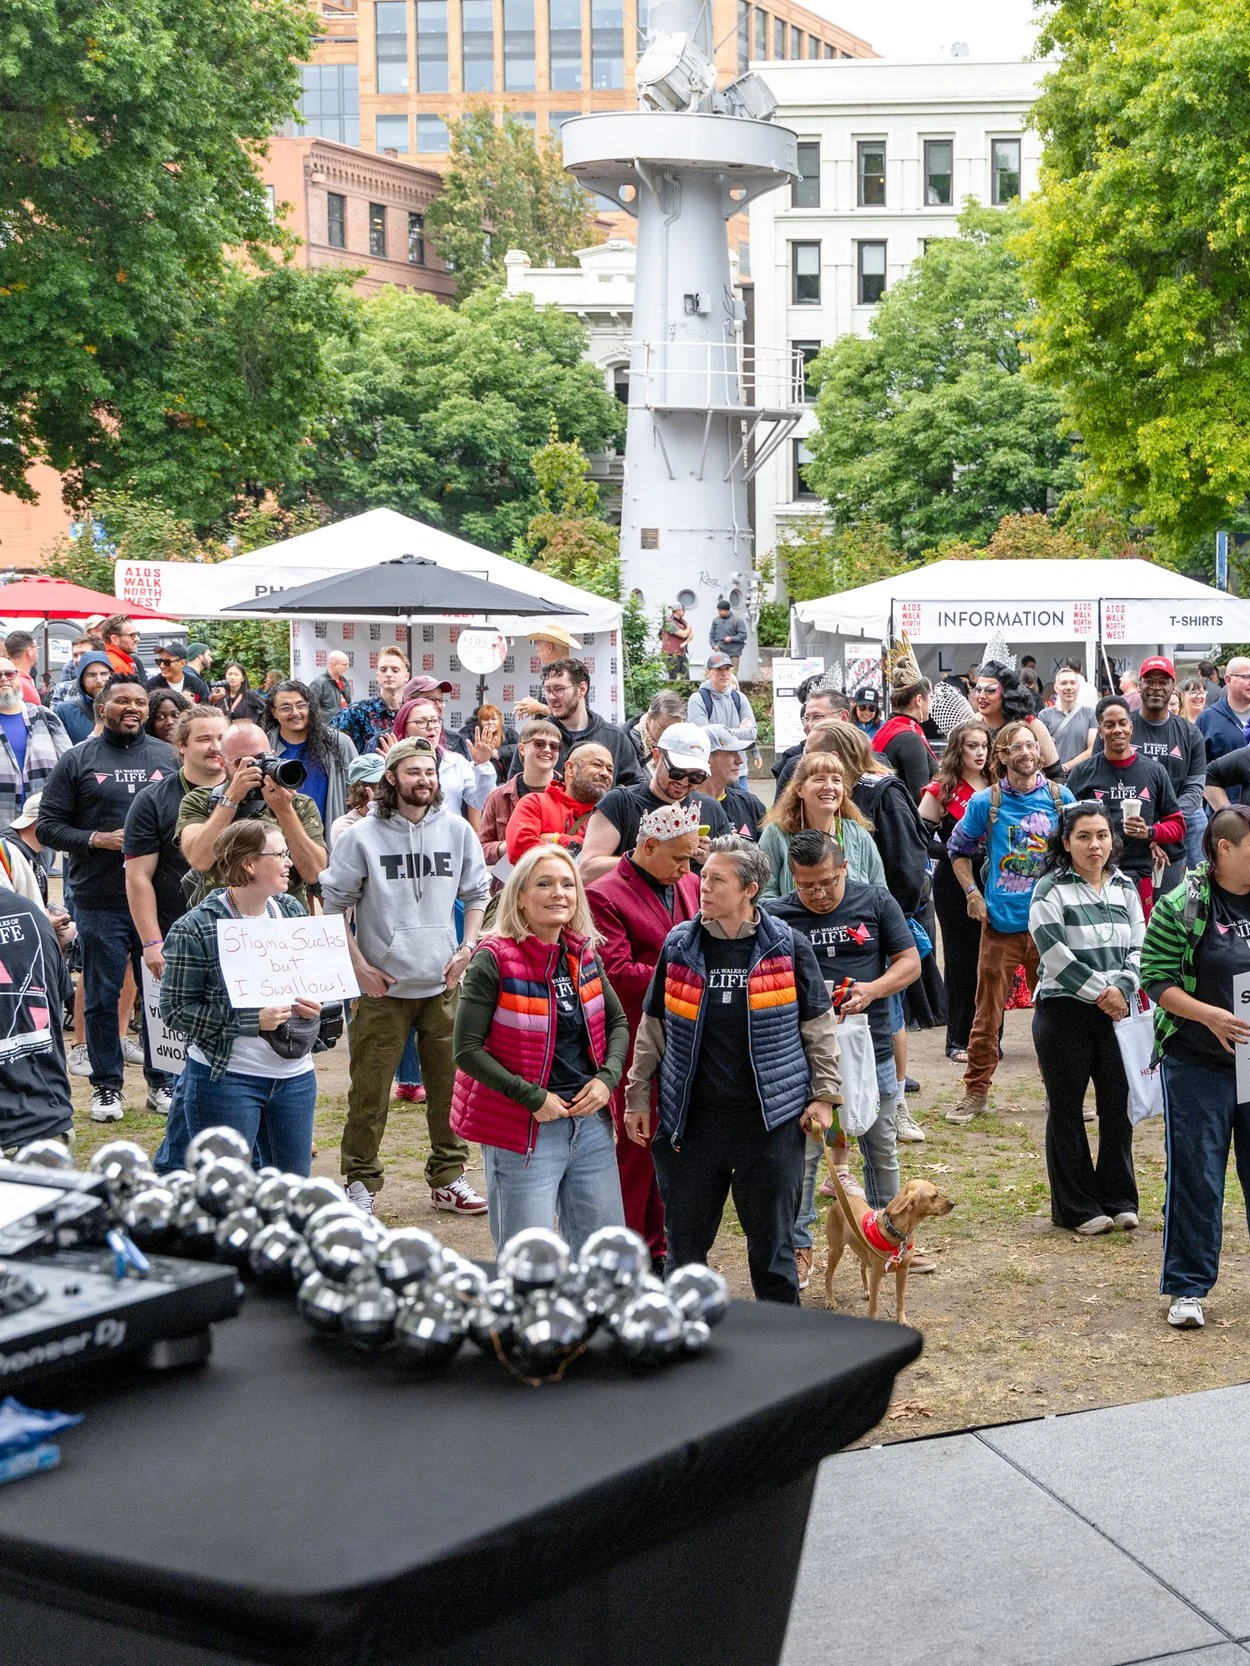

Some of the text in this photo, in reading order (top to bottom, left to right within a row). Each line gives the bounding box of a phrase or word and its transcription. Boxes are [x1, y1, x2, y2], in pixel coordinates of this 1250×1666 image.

[125, 568, 161, 577] AIDS
[124, 578, 161, 587] WALK
[124, 588, 162, 597] NORTH
[938, 611, 1064, 627] INFORMATION
[1170, 616, 1223, 626] T-SHIRTS
[1106, 631, 1125, 639] WEST
[1144, 746, 1168, 756] LIFE
[115, 773, 147, 782] LIFE
[1111, 790, 1137, 799] LIFE
[224, 926, 345, 957] Stigma Sucks
[810, 930, 850, 945] LIFE
[270, 957, 304, 972] but
[234, 974, 346, 997] I Swallow!
[709, 974, 748, 988] LIFE
[157, 1045, 186, 1062] TOMP
